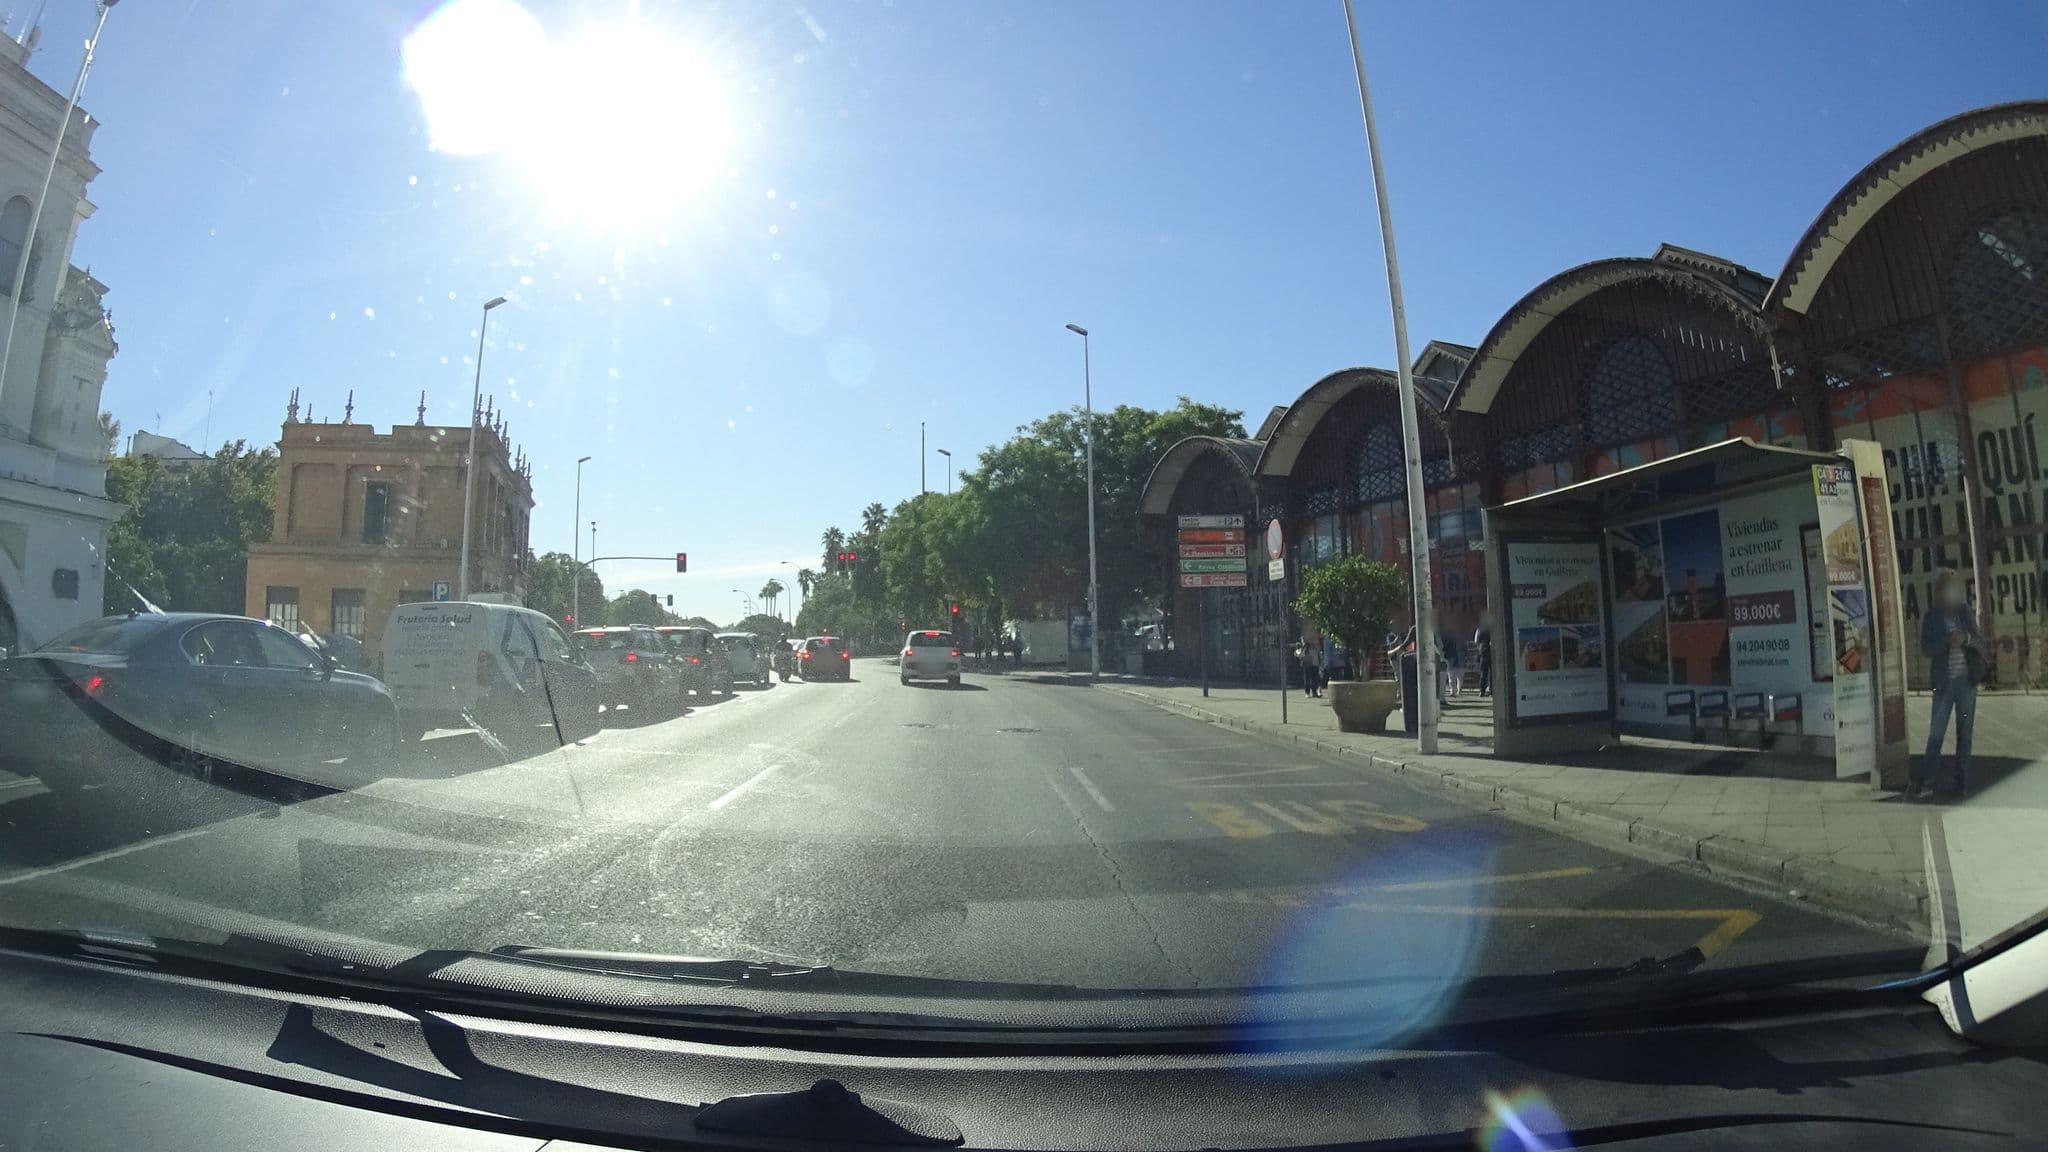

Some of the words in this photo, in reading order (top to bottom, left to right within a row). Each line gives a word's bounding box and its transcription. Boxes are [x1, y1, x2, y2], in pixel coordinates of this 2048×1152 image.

[1727, 516, 1778, 539] Viviendas
[1729, 546, 1736, 558] a
[1736, 538, 1784, 557] estrenar
[1731, 564, 1744, 577] en
[1746, 557, 1793, 575] Guillena
[436, 583, 448, 600] P
[1734, 603, 1781, 621] 99.000€
